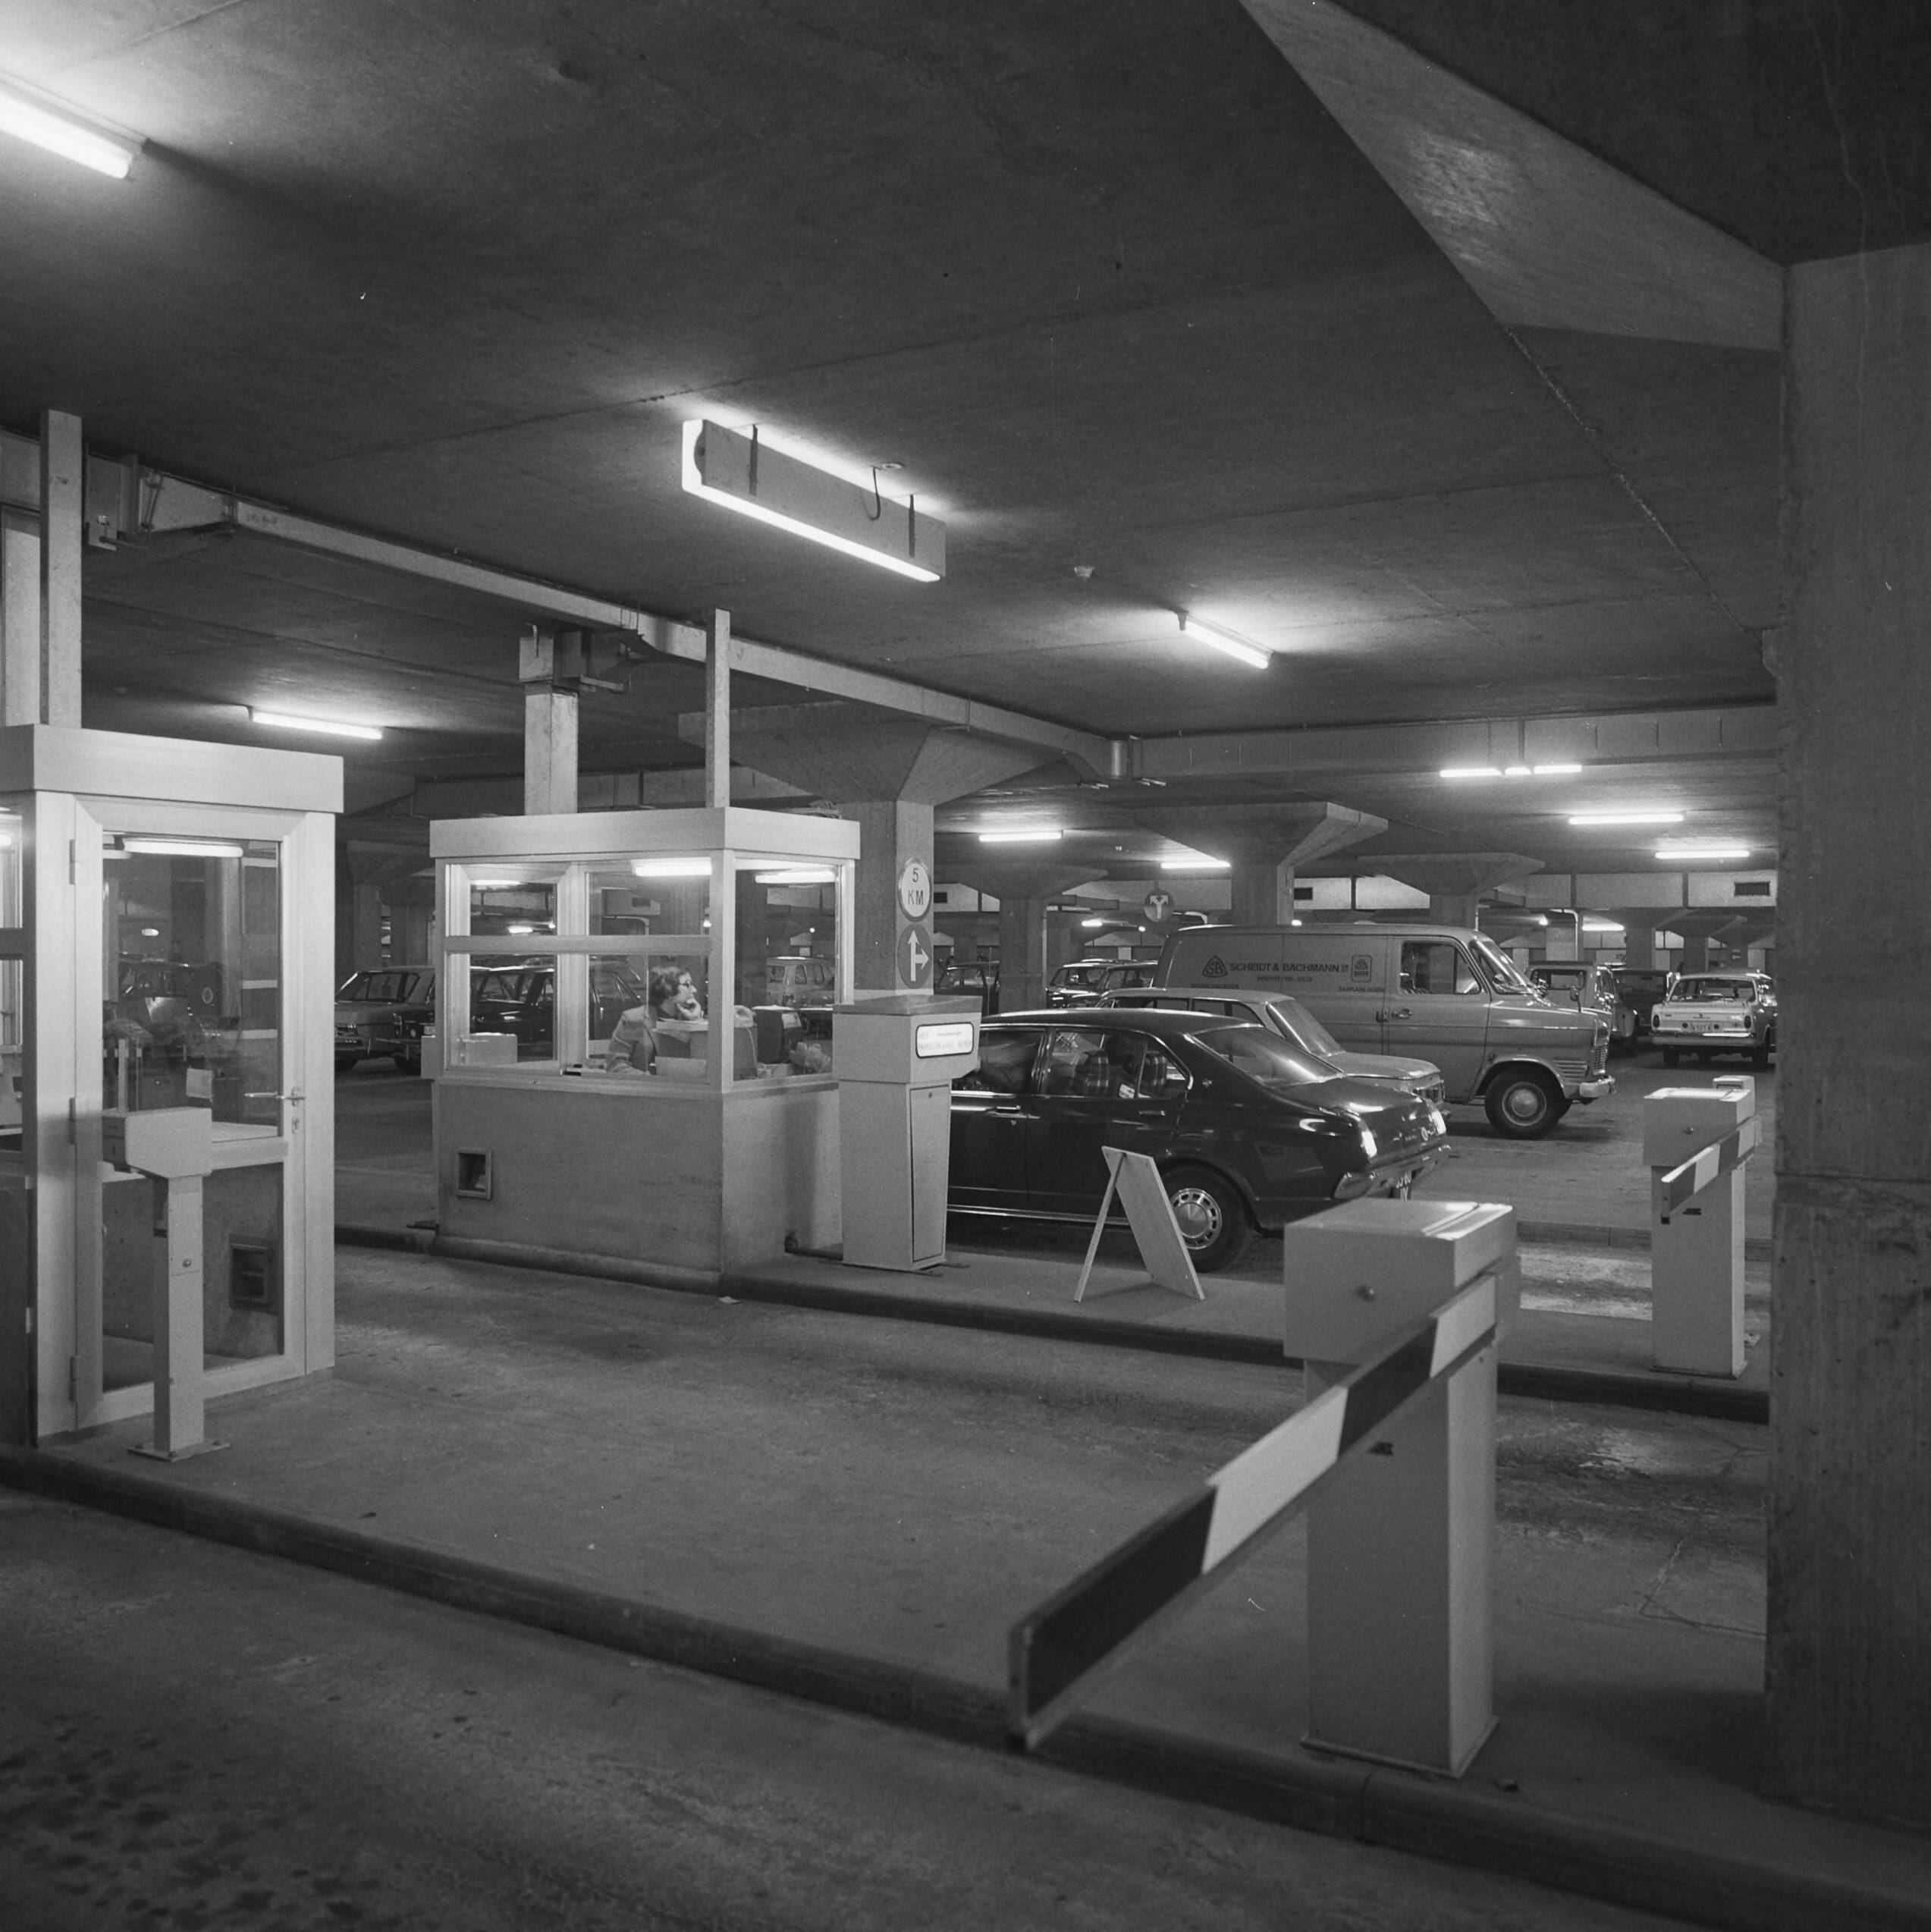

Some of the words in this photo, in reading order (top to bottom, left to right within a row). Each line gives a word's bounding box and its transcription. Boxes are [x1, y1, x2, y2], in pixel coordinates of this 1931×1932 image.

[912, 867, 919, 883] 5
[908, 890, 924, 905] KM
[1229, 963, 1271, 972] SCHEIDT
[1273, 963, 1279, 972] &
[1283, 963, 1339, 972] BACHMANN
